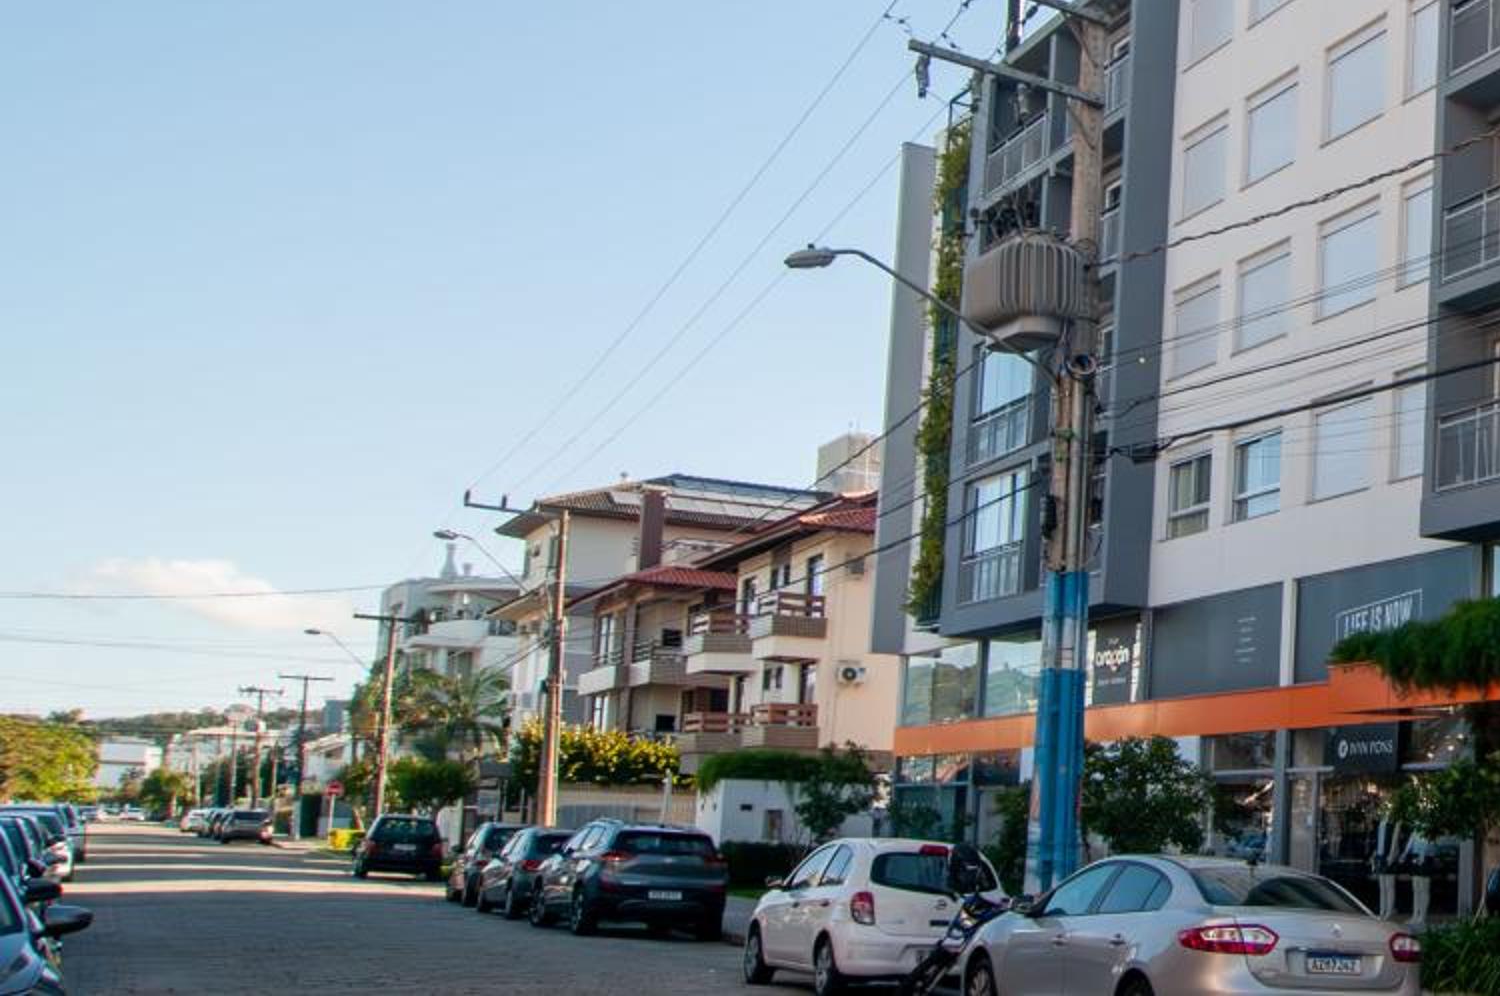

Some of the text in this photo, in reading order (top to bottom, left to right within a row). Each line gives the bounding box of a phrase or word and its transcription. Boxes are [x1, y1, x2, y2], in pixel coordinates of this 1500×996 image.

[1344, 596, 1413, 638] LIFE IS NOW
